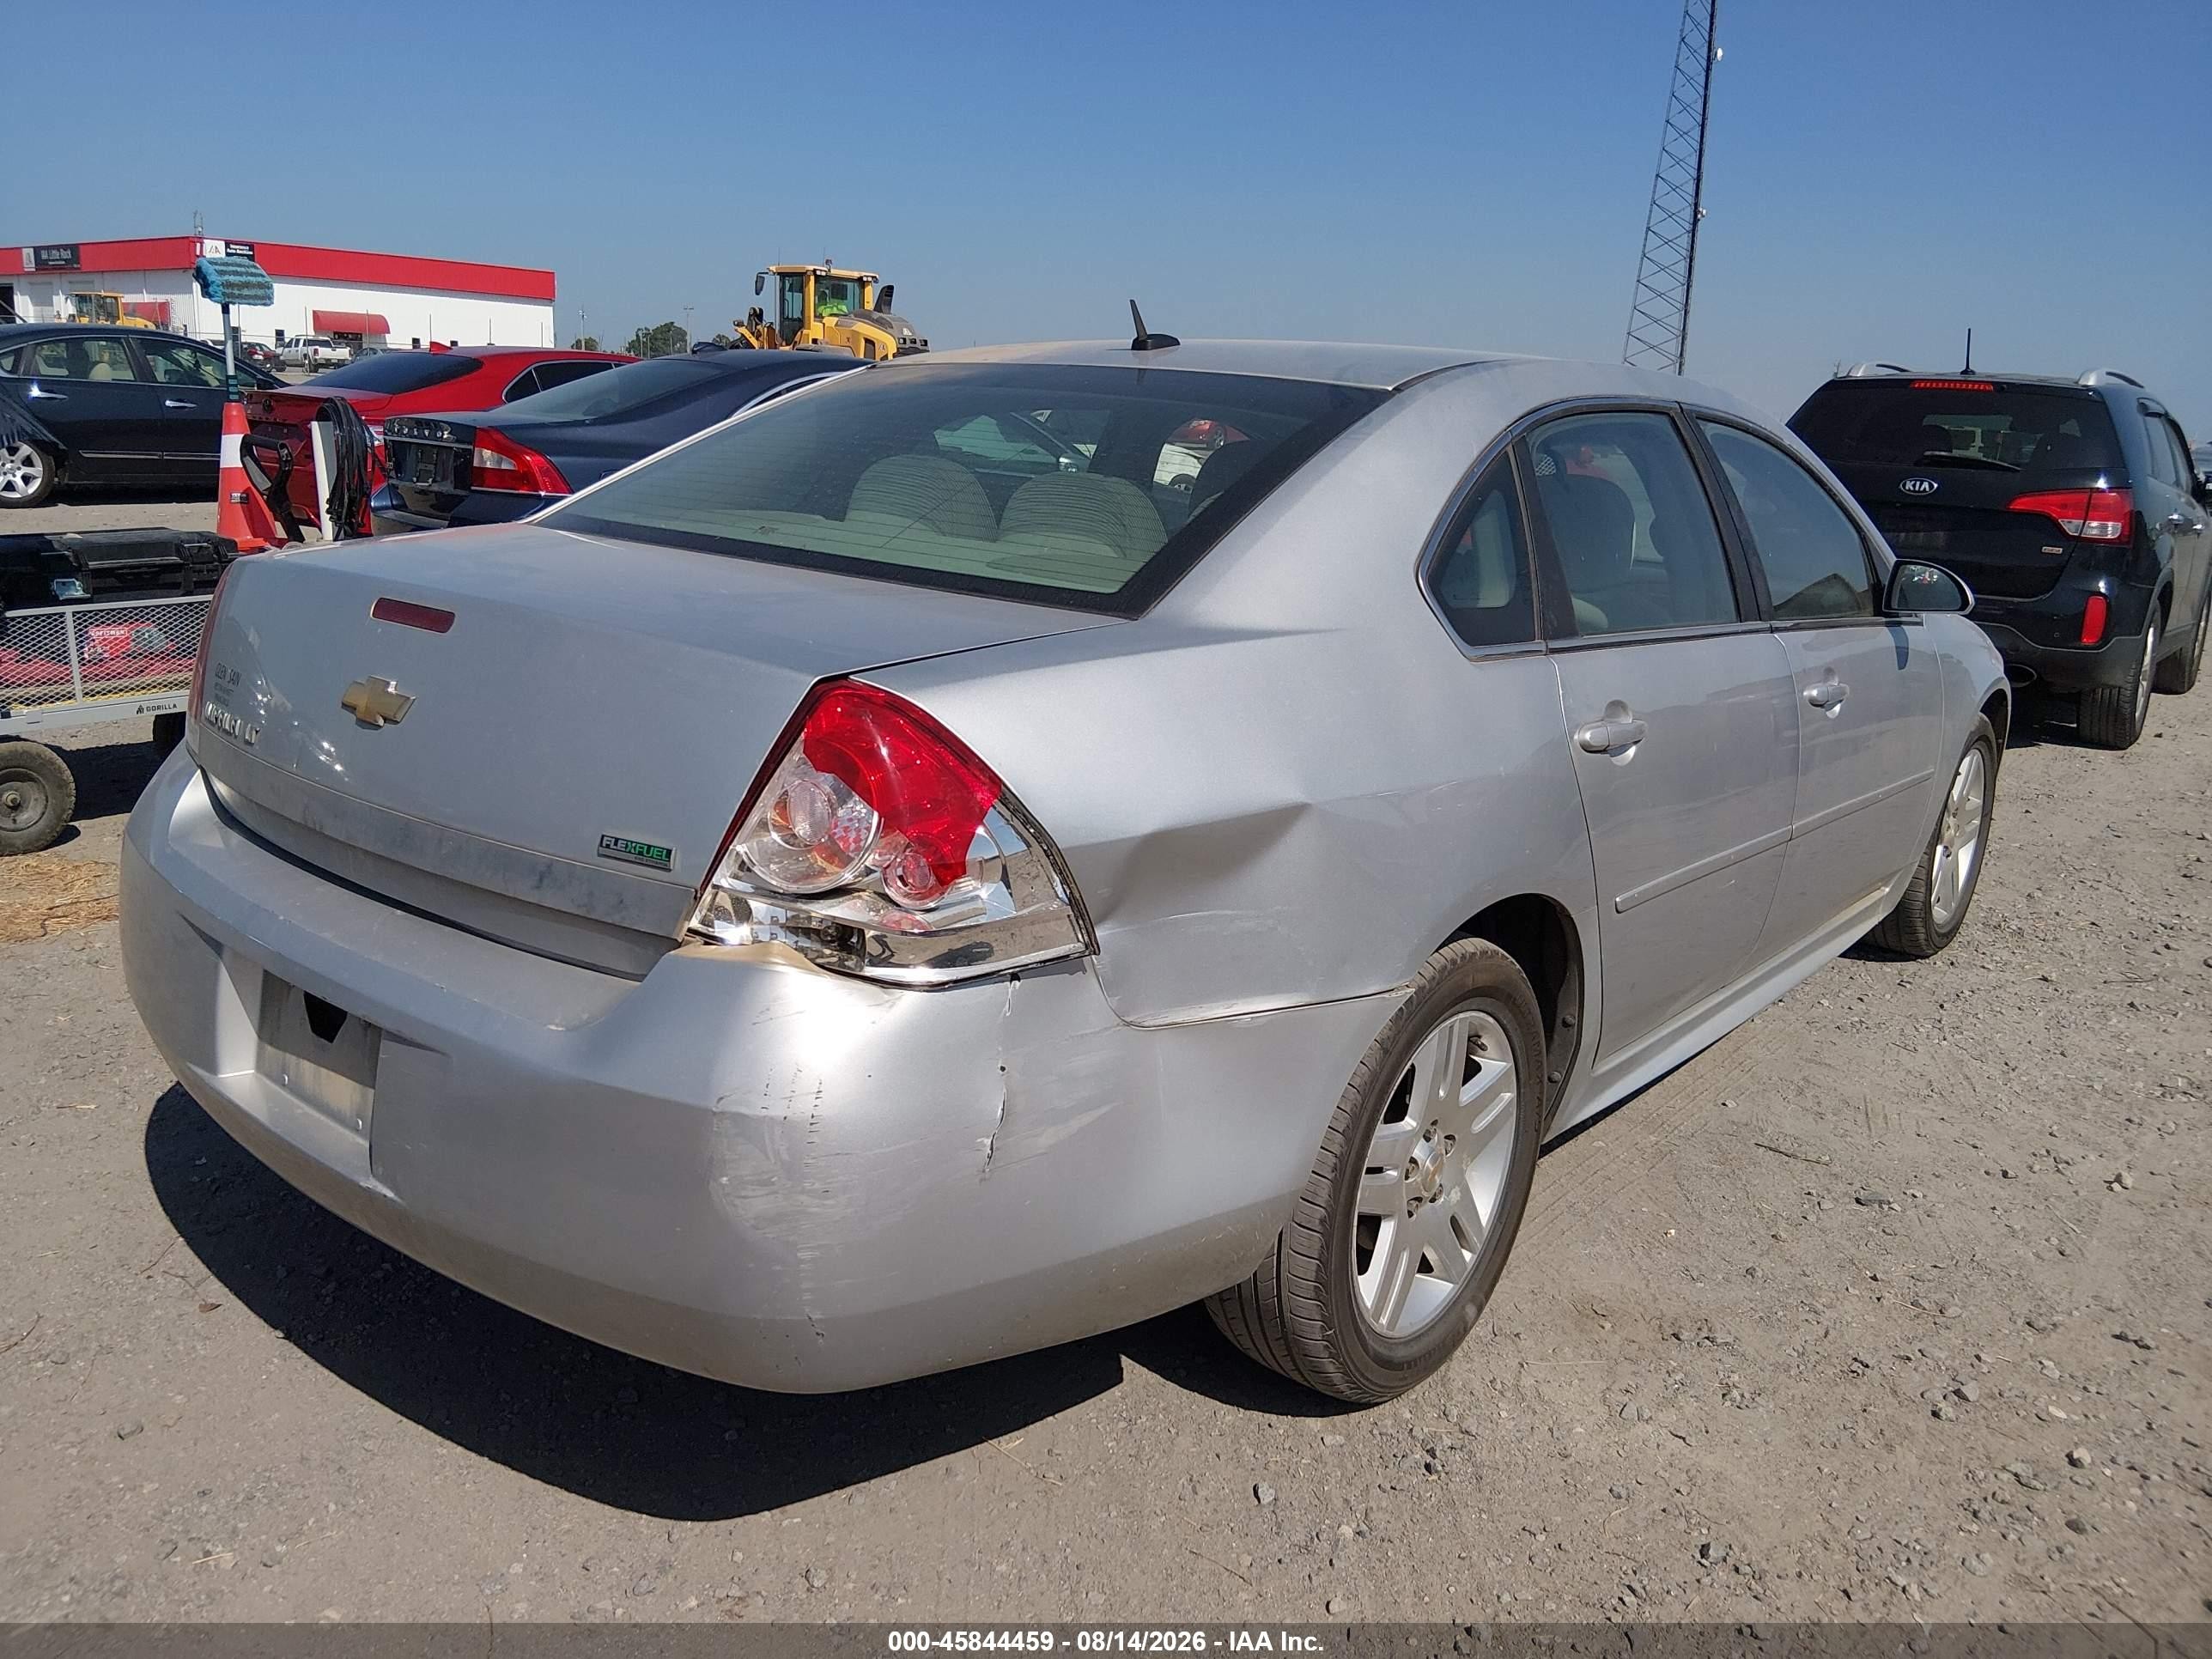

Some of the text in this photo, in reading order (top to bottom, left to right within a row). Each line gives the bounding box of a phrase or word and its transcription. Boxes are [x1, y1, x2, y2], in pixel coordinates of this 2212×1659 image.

[1905, 480, 1930, 491] KIA
[146, 703, 178, 713] GORILLA
[602, 836, 671, 861] FLEXFUEL
